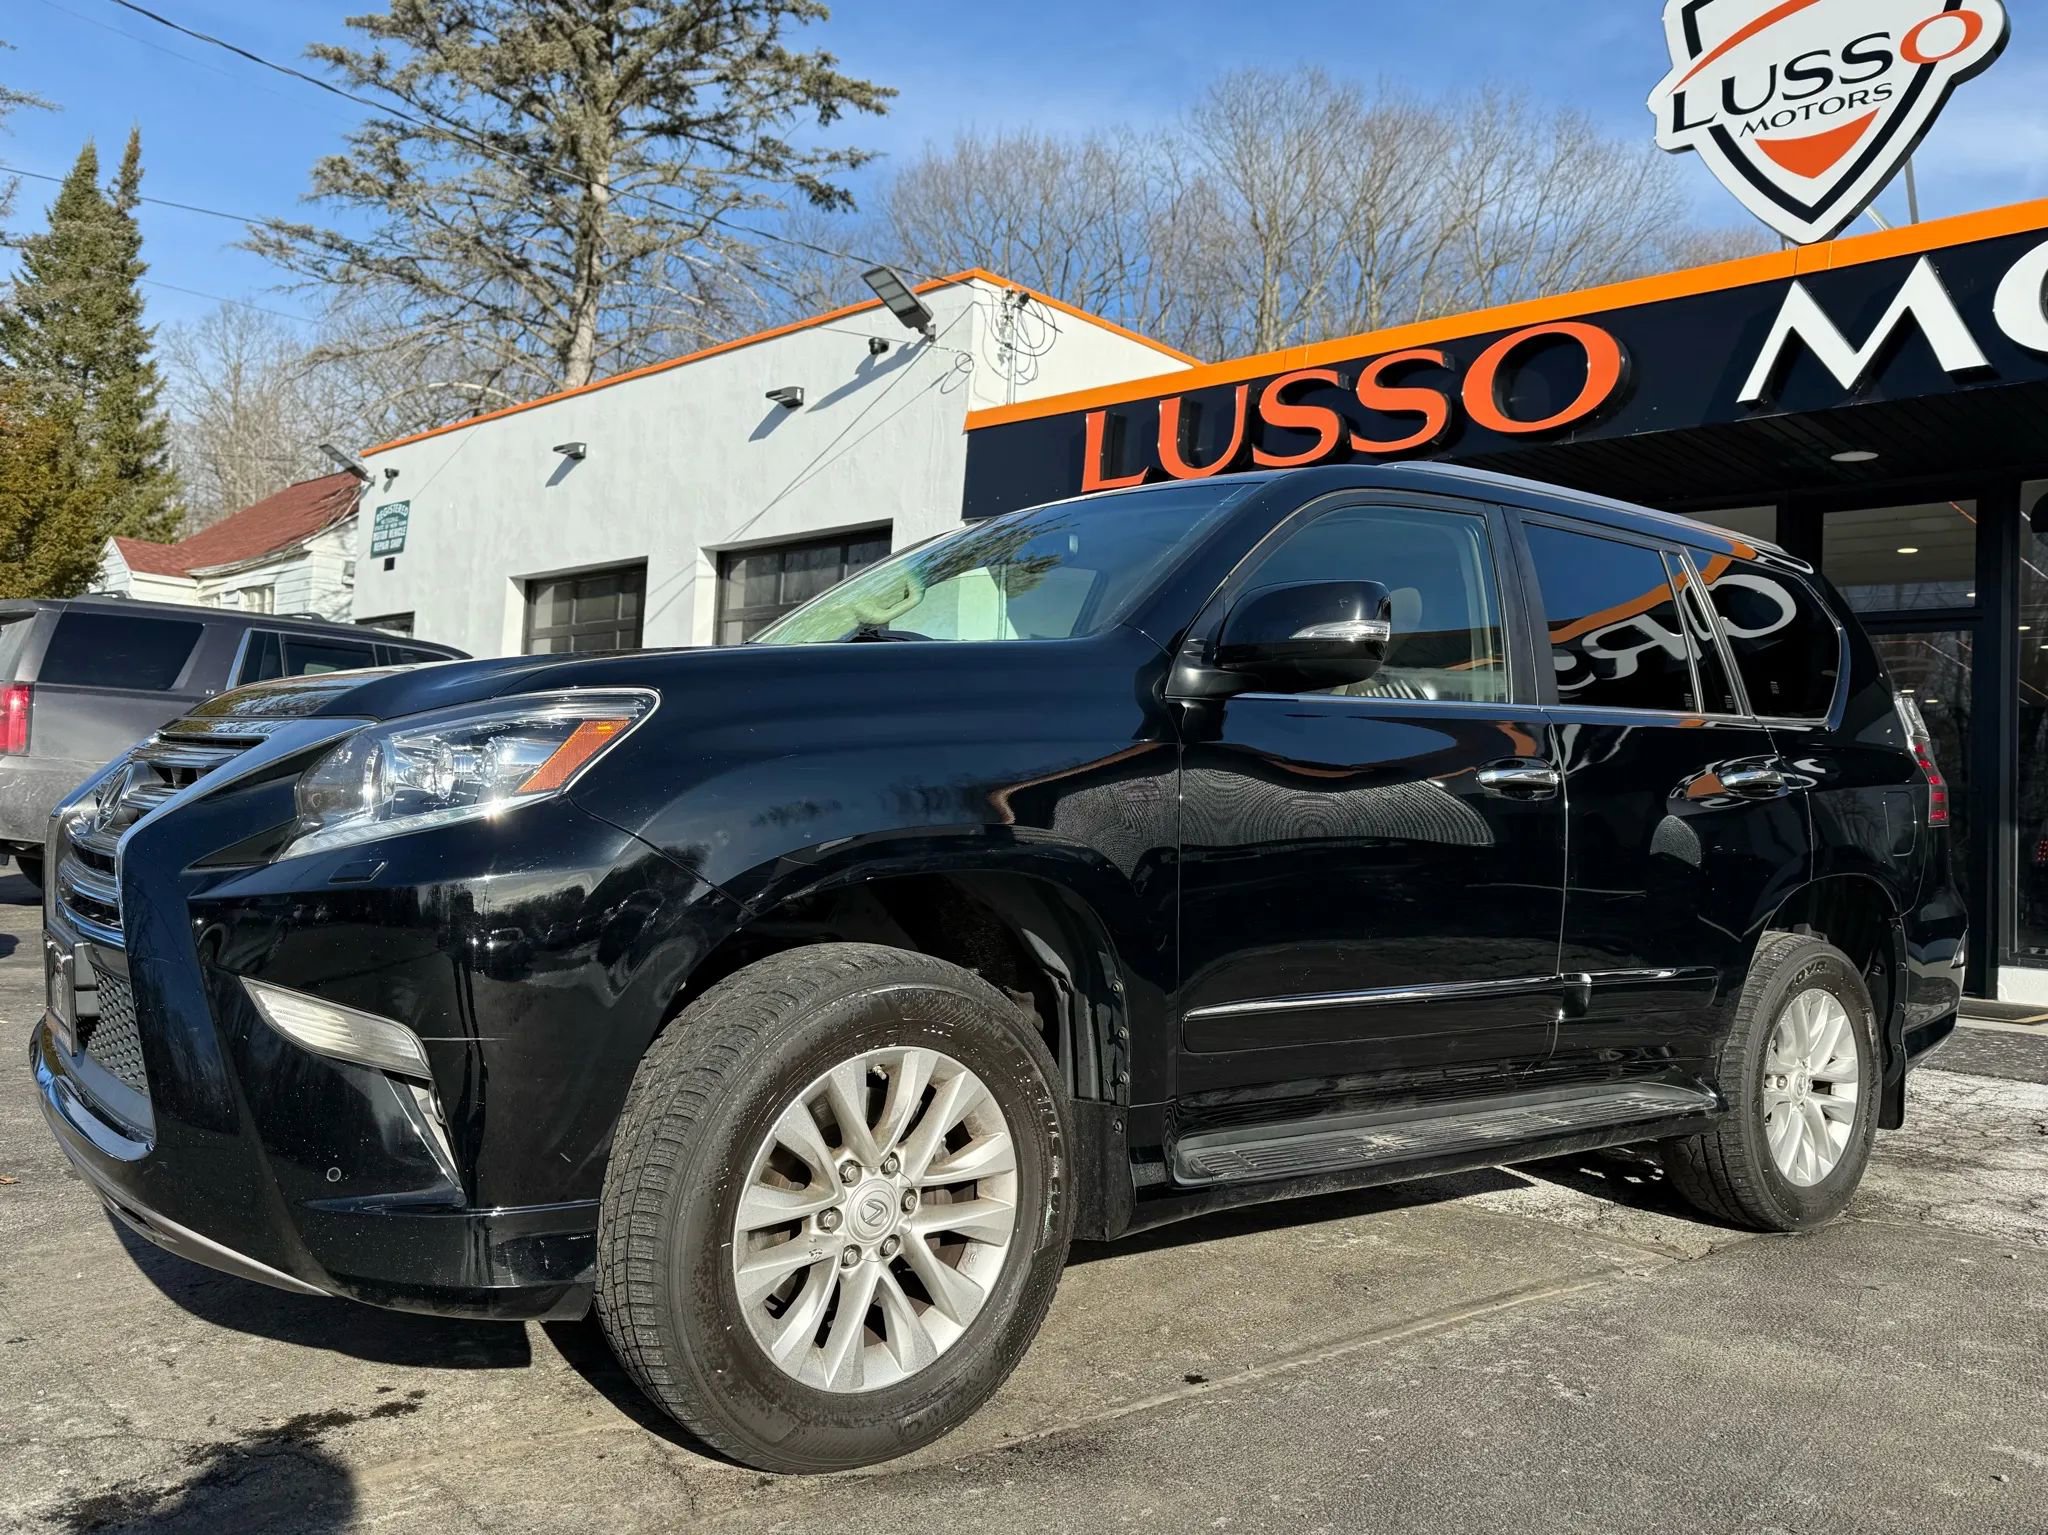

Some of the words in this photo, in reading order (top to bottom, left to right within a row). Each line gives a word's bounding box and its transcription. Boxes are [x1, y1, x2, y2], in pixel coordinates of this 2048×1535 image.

[1672, 9, 1983, 134] LUSSO
[1739, 82, 1893, 137] MOTORS
[1081, 321, 1627, 492] LUSSO
[1736, 240, 2048, 403] M
